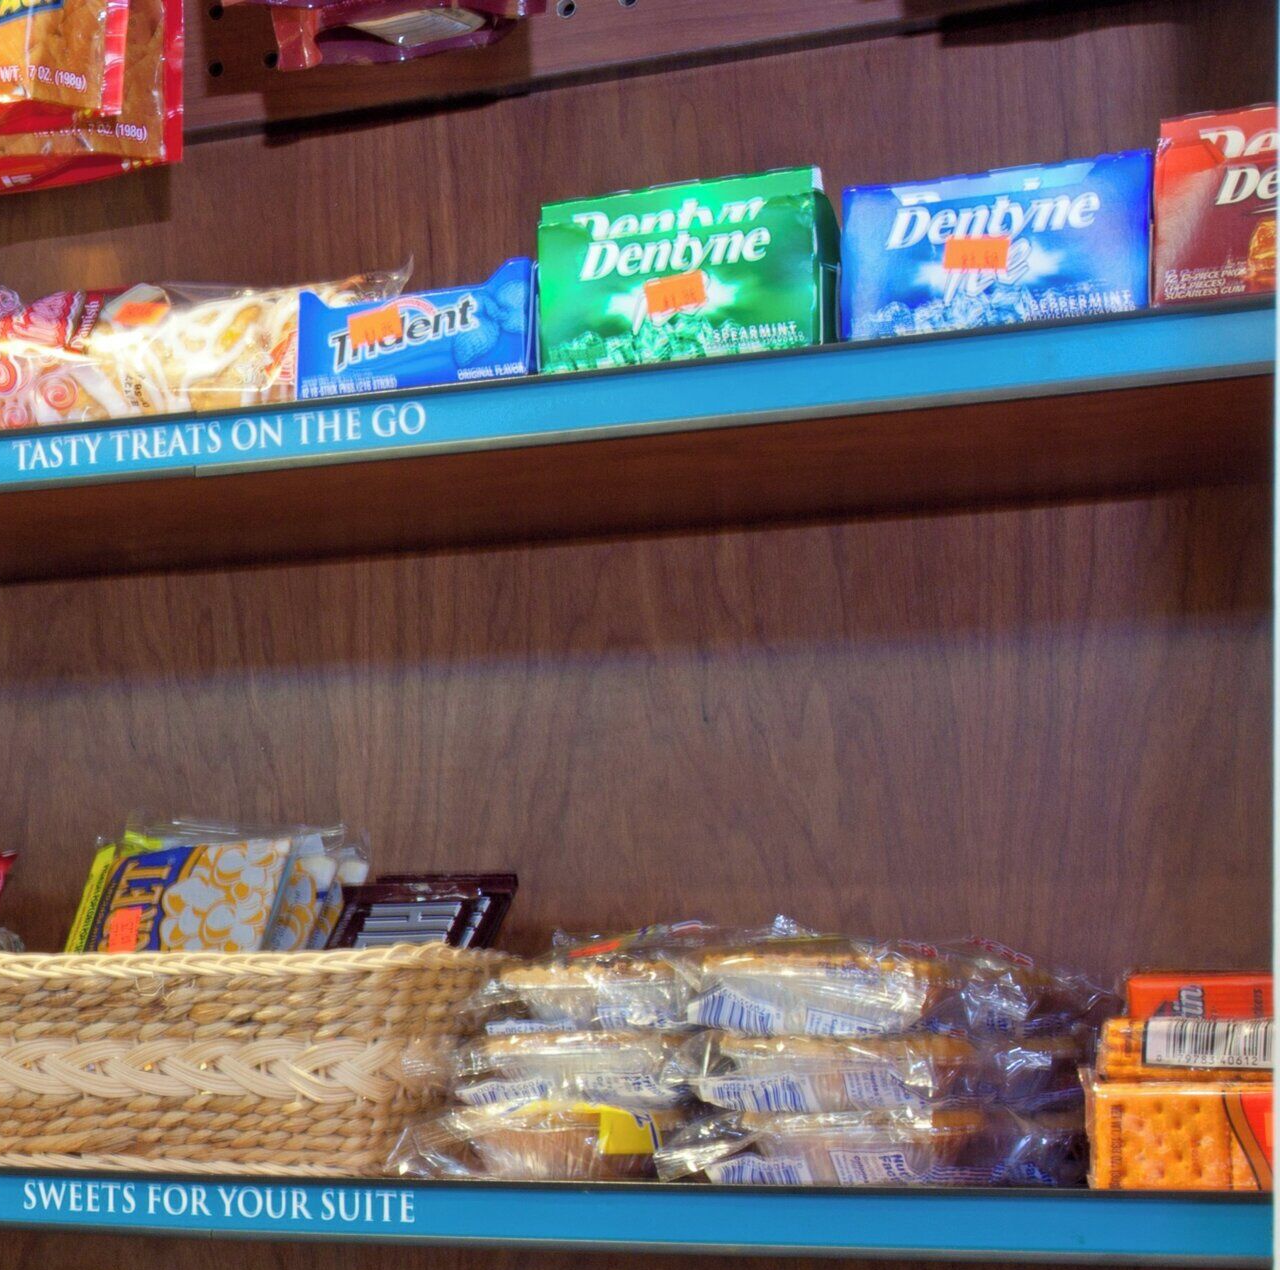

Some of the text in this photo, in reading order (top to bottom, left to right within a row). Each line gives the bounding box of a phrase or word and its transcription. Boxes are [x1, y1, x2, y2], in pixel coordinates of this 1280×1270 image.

[0, 65, 23, 83] WT.
[54, 70, 88, 93] (198g)
[115, 123, 148, 142] (198g)
[886, 188, 1101, 252] Dentyne
[579, 227, 771, 281] Dentyne
[1029, 288, 1132, 311] PEPPERMINT
[712, 321, 798, 342] SPEARMINT
[14, 402, 426, 471] TASTY TREATS ON THE GO
[1178, 1055, 1258, 1065] 79783 40612
[24, 1179, 415, 1223] SWEETS FOR YOUR SUITE
